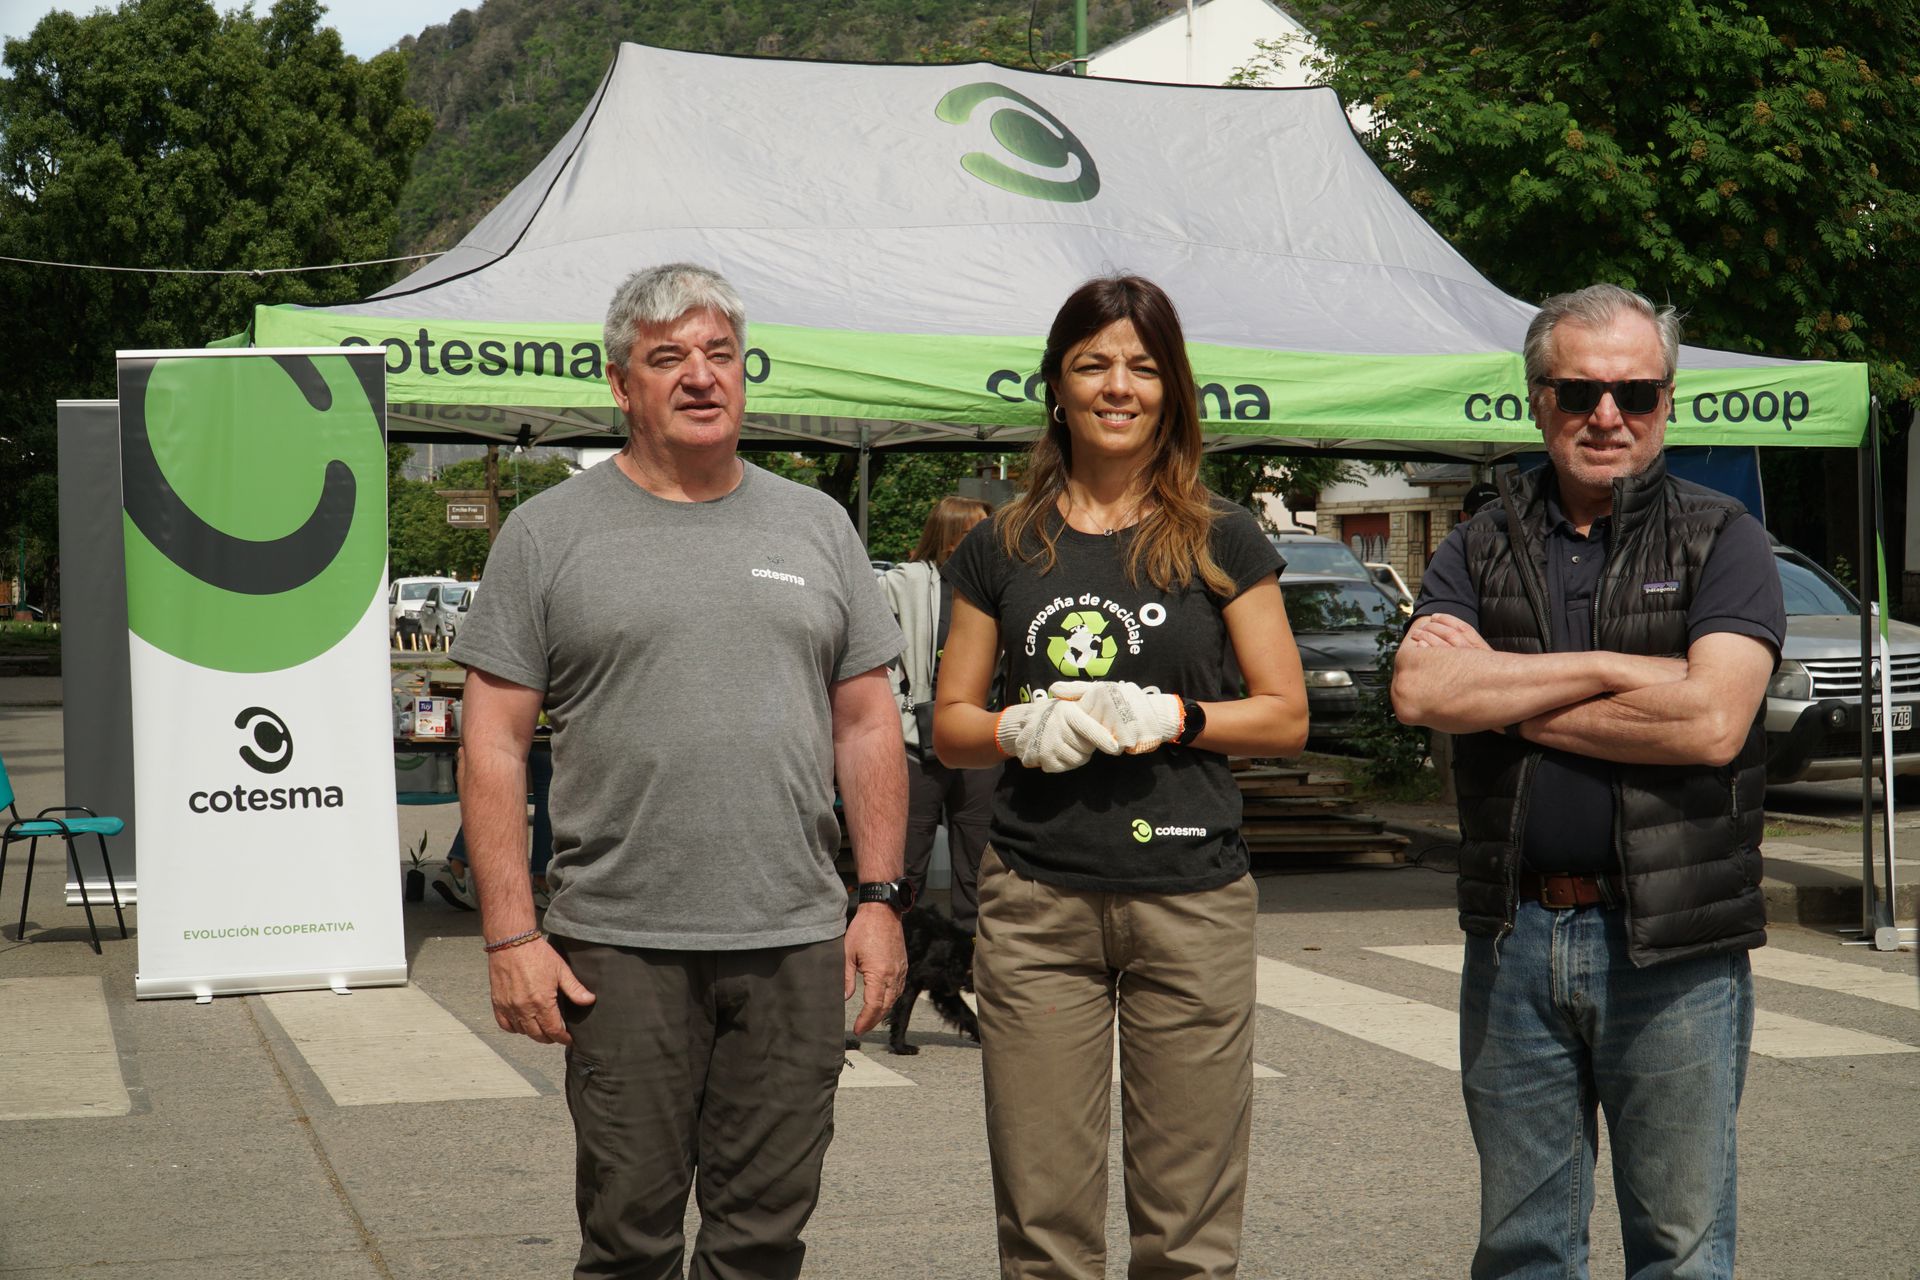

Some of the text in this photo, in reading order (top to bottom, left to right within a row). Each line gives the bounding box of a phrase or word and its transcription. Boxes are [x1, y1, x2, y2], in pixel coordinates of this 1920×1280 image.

[340, 328, 603, 379] otesma
[1692, 391, 1810, 431] coop
[752, 568, 805, 586] cotesma
[1025, 593, 1144, 656] Campaña de reciclaje
[1892, 712, 1910, 727] 748
[188, 784, 344, 814] cotesma
[1155, 825, 1207, 837] cotesma
[183, 921, 355, 940] EVOLUCIÓN COOPERATIVA
